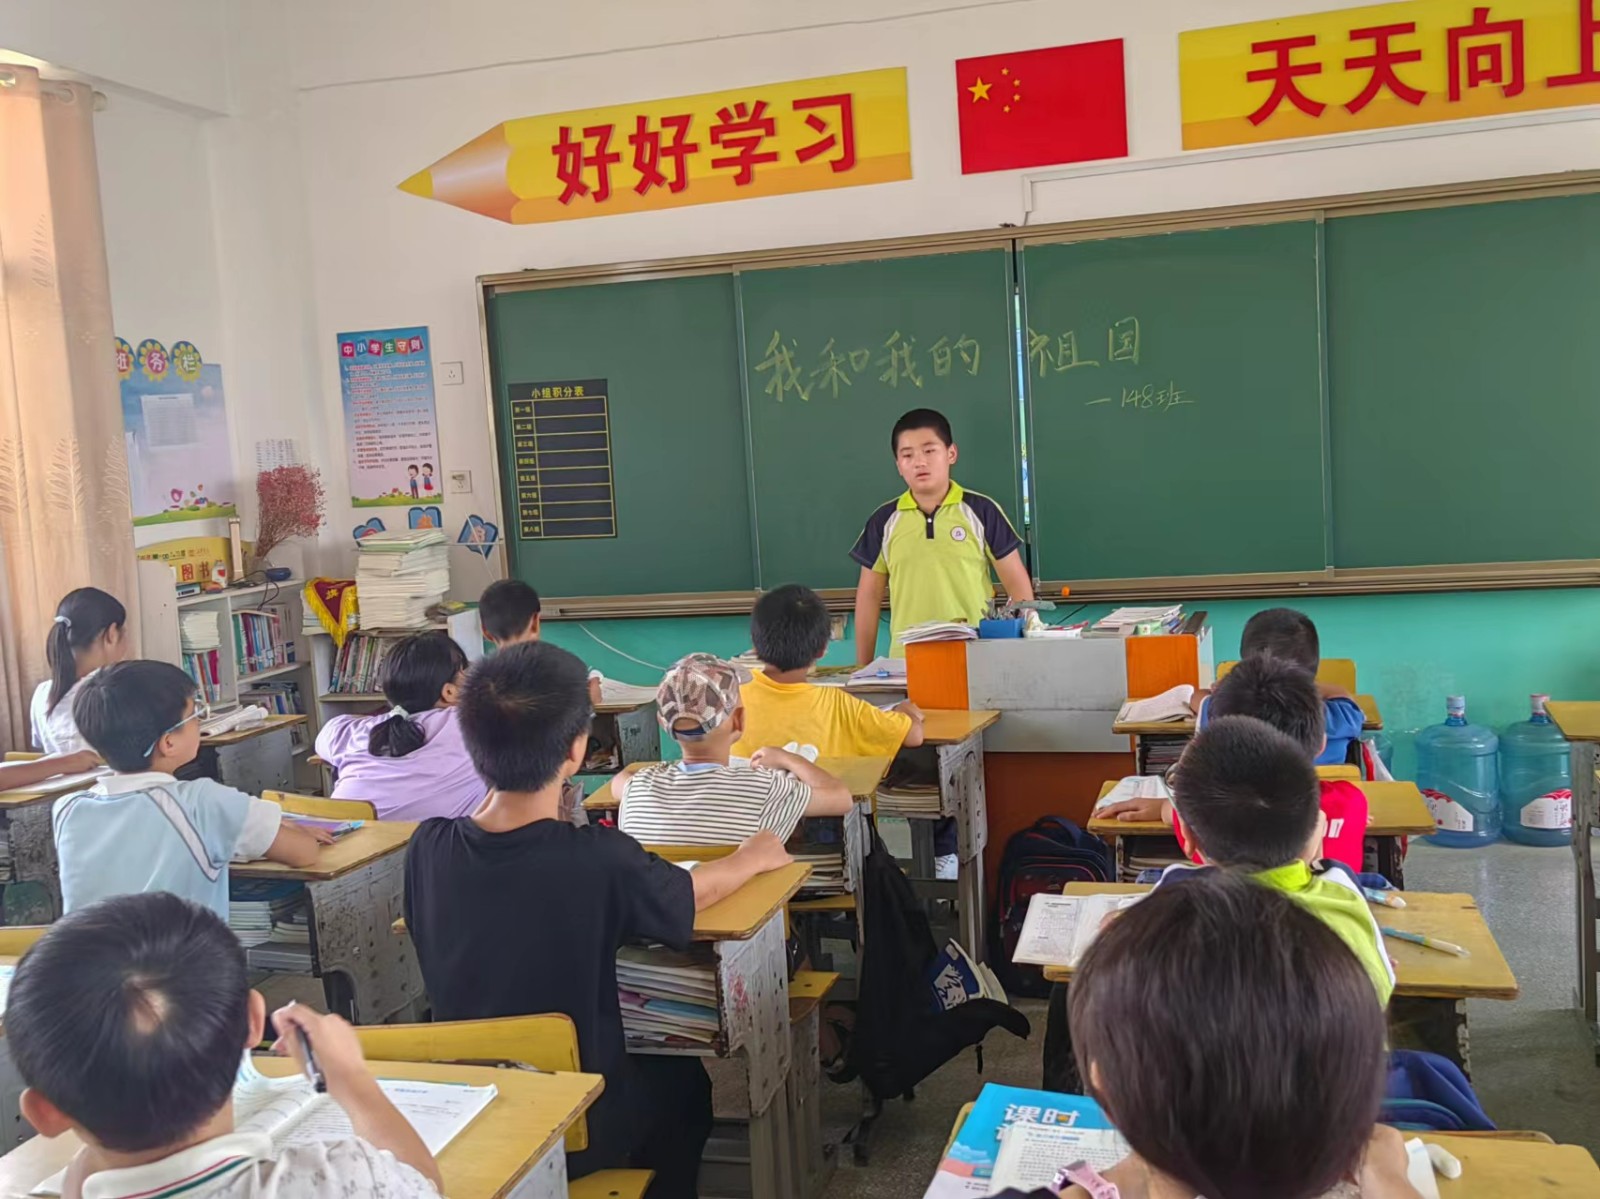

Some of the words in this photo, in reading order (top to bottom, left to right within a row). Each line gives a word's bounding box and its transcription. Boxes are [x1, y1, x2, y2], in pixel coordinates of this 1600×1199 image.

[1247, 0, 1600, 125] 天天向上
[552, 92, 857, 204] 好好学习
[343, 340, 421, 355] 中小学生守则
[531, 386, 584, 398] 小组积分表
[1004, 1104, 1080, 1126] 课时
